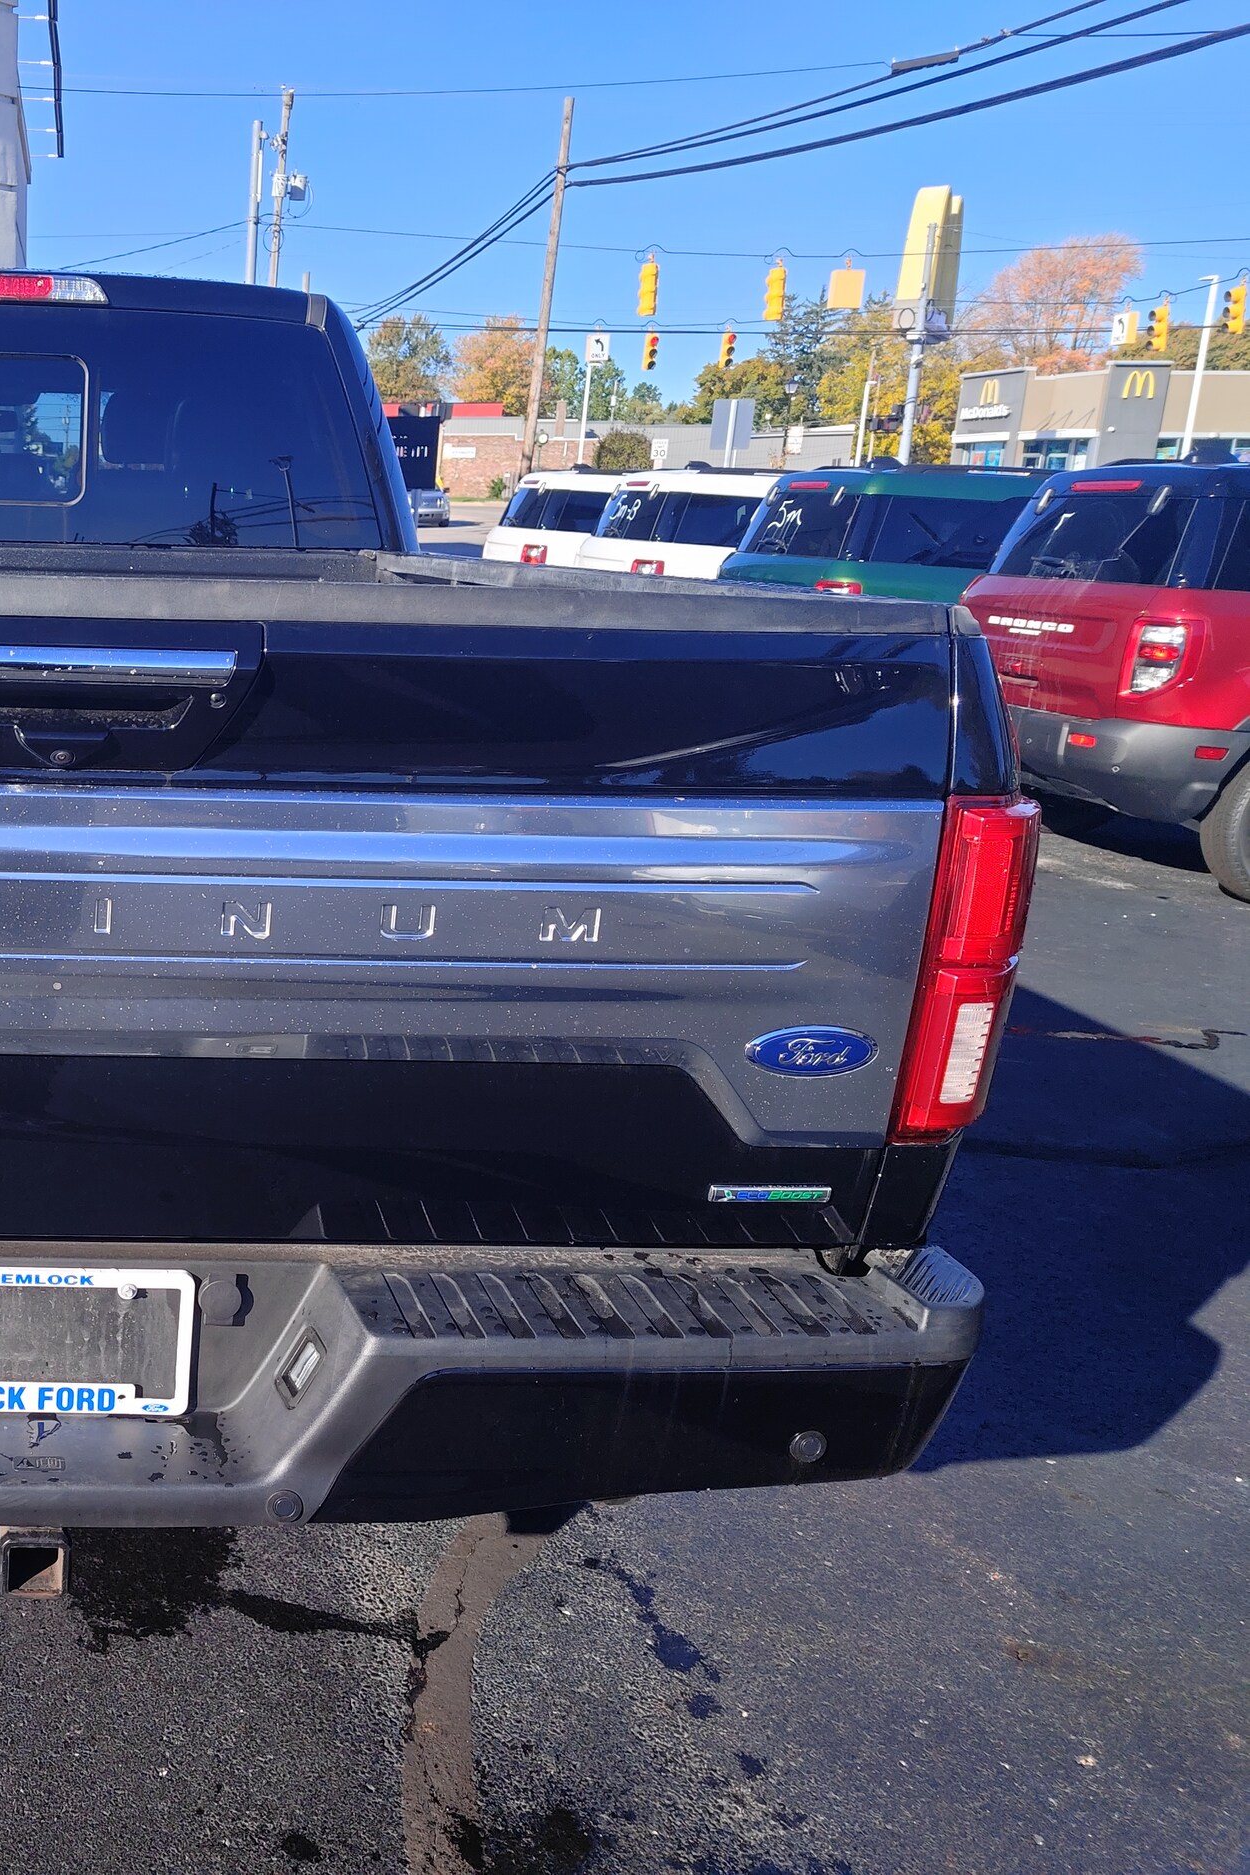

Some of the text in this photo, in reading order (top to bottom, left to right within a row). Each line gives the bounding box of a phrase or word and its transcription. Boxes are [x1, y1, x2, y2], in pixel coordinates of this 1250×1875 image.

[960, 403, 1011, 420] McDonald's
[652, 449, 666, 457] 30
[988, 615, 1075, 633] BRONCO
[778, 1038, 852, 1067] Ford
[37, 1387, 116, 1412] FORD
